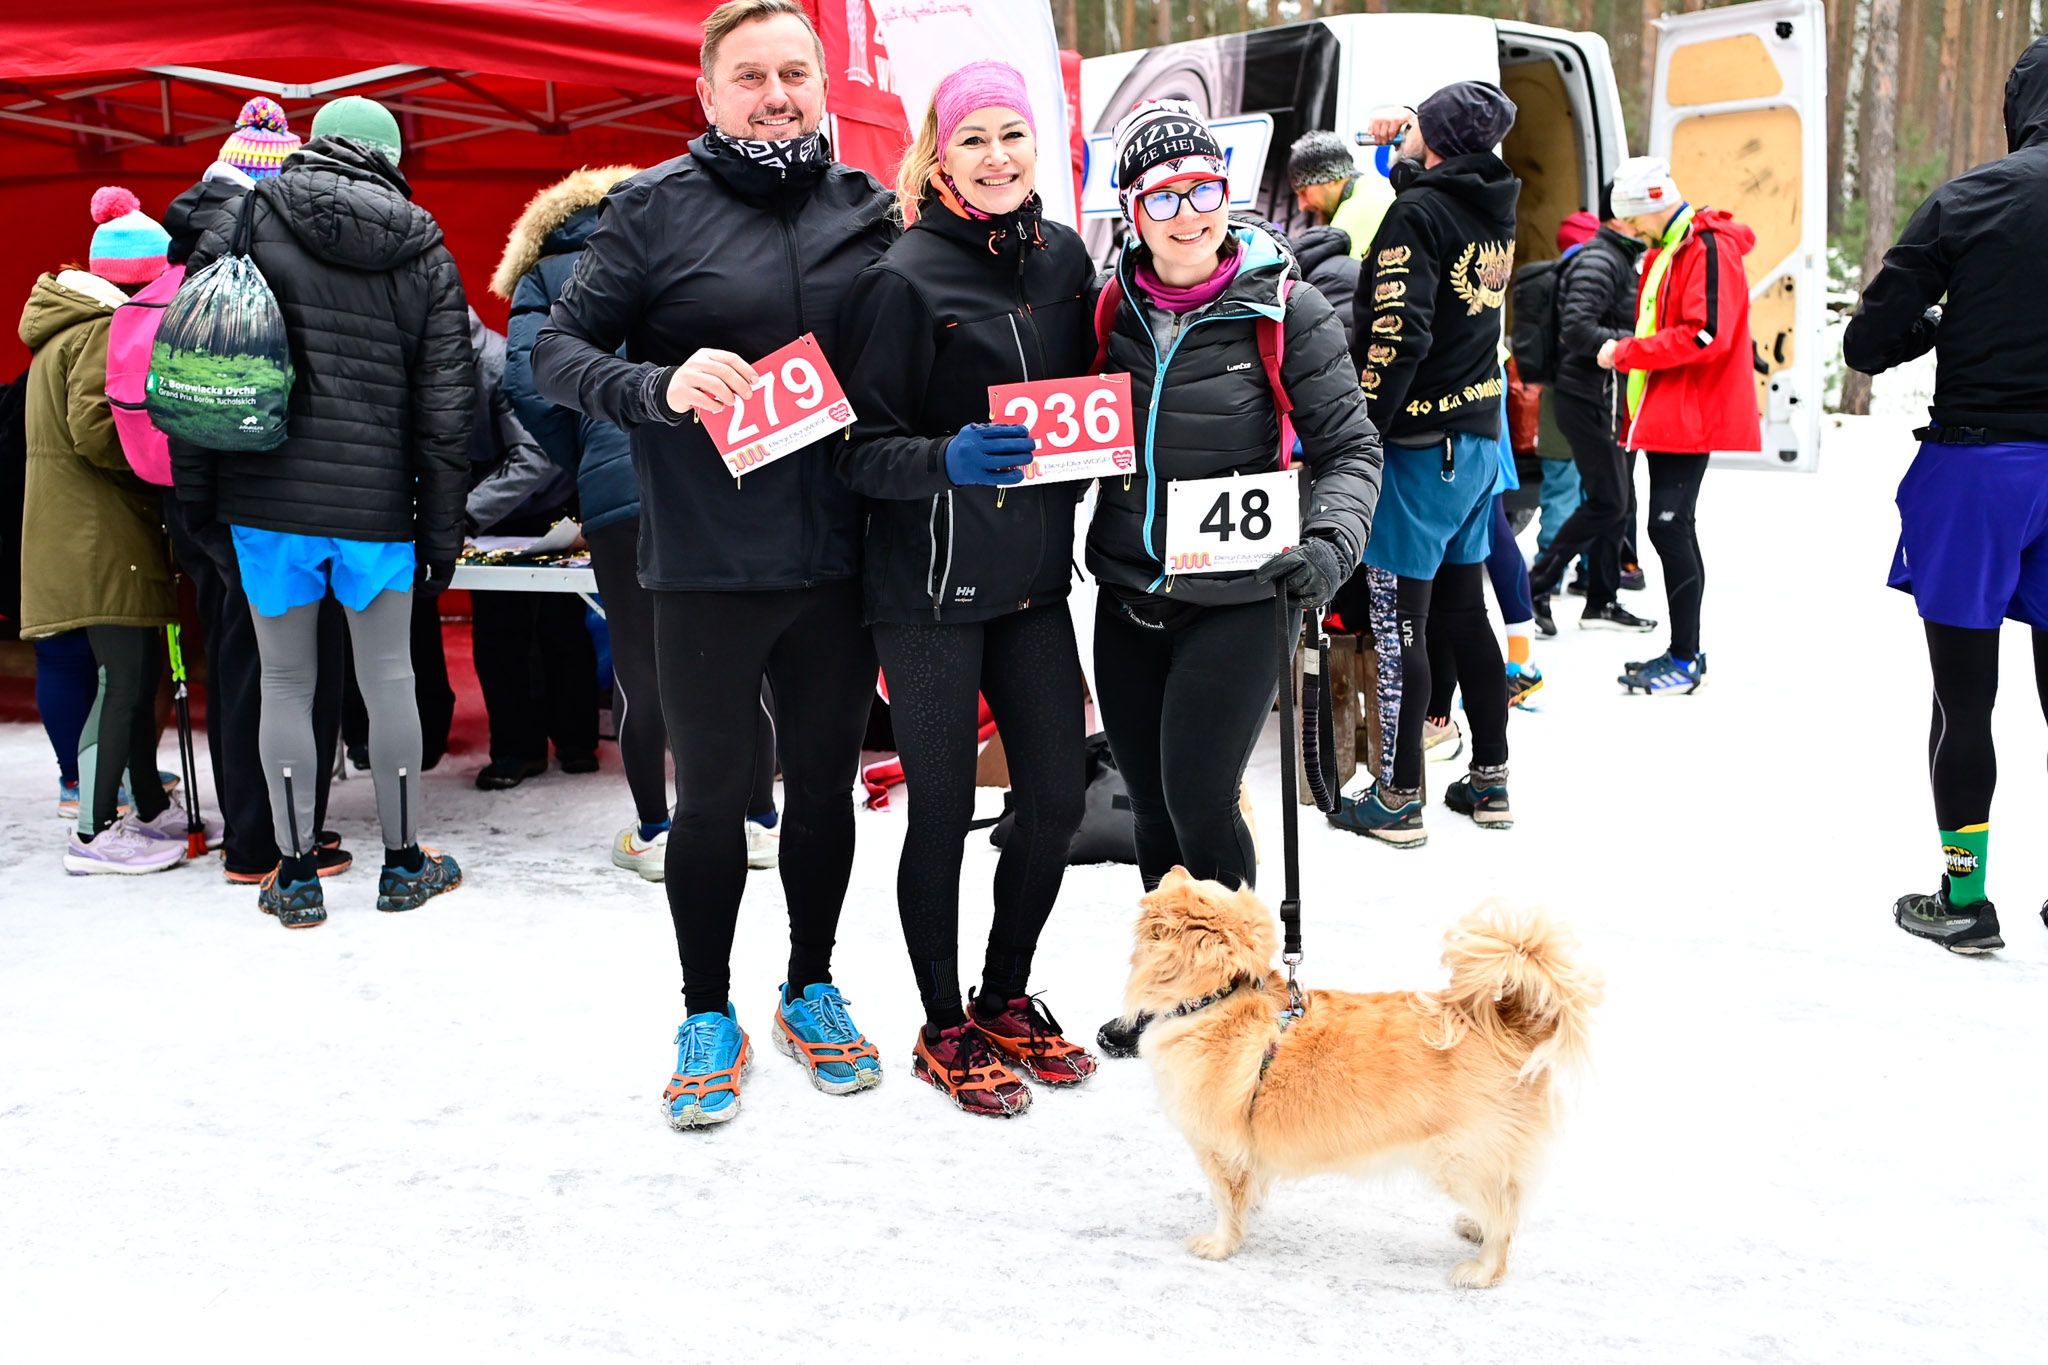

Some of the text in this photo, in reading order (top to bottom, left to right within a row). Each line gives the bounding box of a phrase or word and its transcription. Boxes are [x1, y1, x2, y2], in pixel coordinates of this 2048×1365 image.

[1163, 139, 1195, 154] HEJ
[158, 388, 179, 399] Grand
[179, 393, 193, 401] Prix
[216, 397, 257, 406] Tucholskich
[168, 380, 223, 395] Borowiacka
[225, 386, 257, 398] Dycha
[727, 357, 824, 445] 279
[1004, 388, 1120, 449] 236
[1199, 488, 1272, 542] 48
